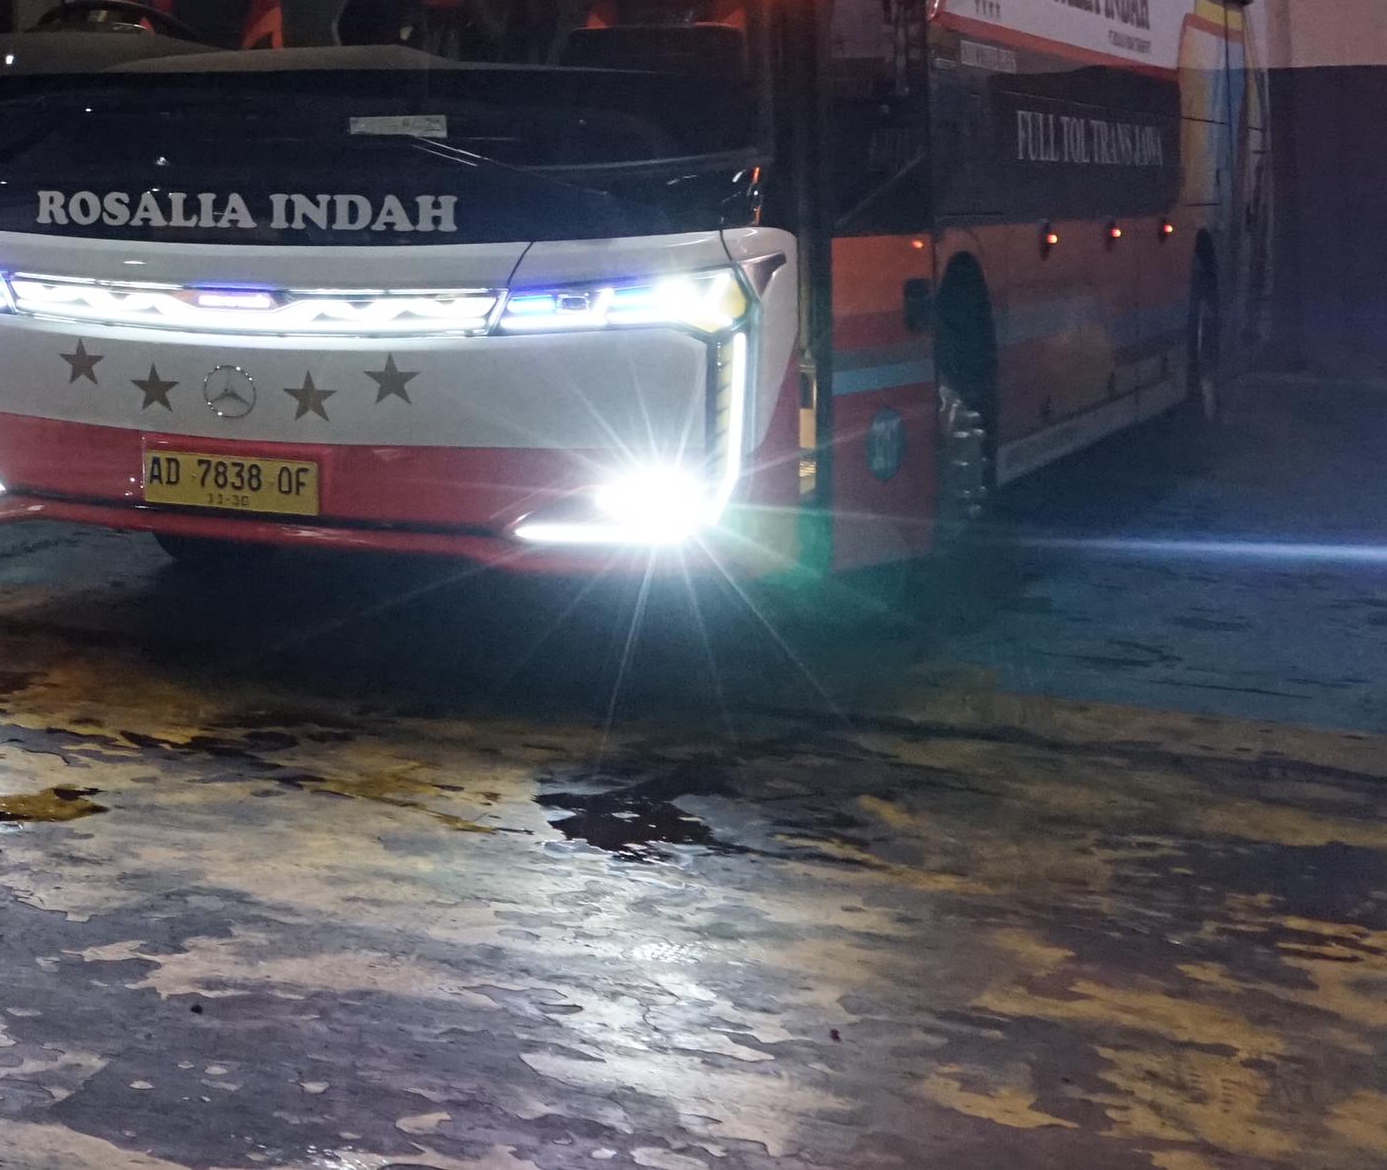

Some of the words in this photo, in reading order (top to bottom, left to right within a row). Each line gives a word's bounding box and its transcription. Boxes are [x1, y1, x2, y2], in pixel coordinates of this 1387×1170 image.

[1016, 110, 1060, 162] FULL
[1060, 116, 1091, 164] TOL
[35, 190, 258, 229] ROSALIA
[268, 193, 459, 232] INDAH
[149, 456, 181, 485] AD
[197, 459, 263, 492] 7838
[278, 466, 310, 496] OF
